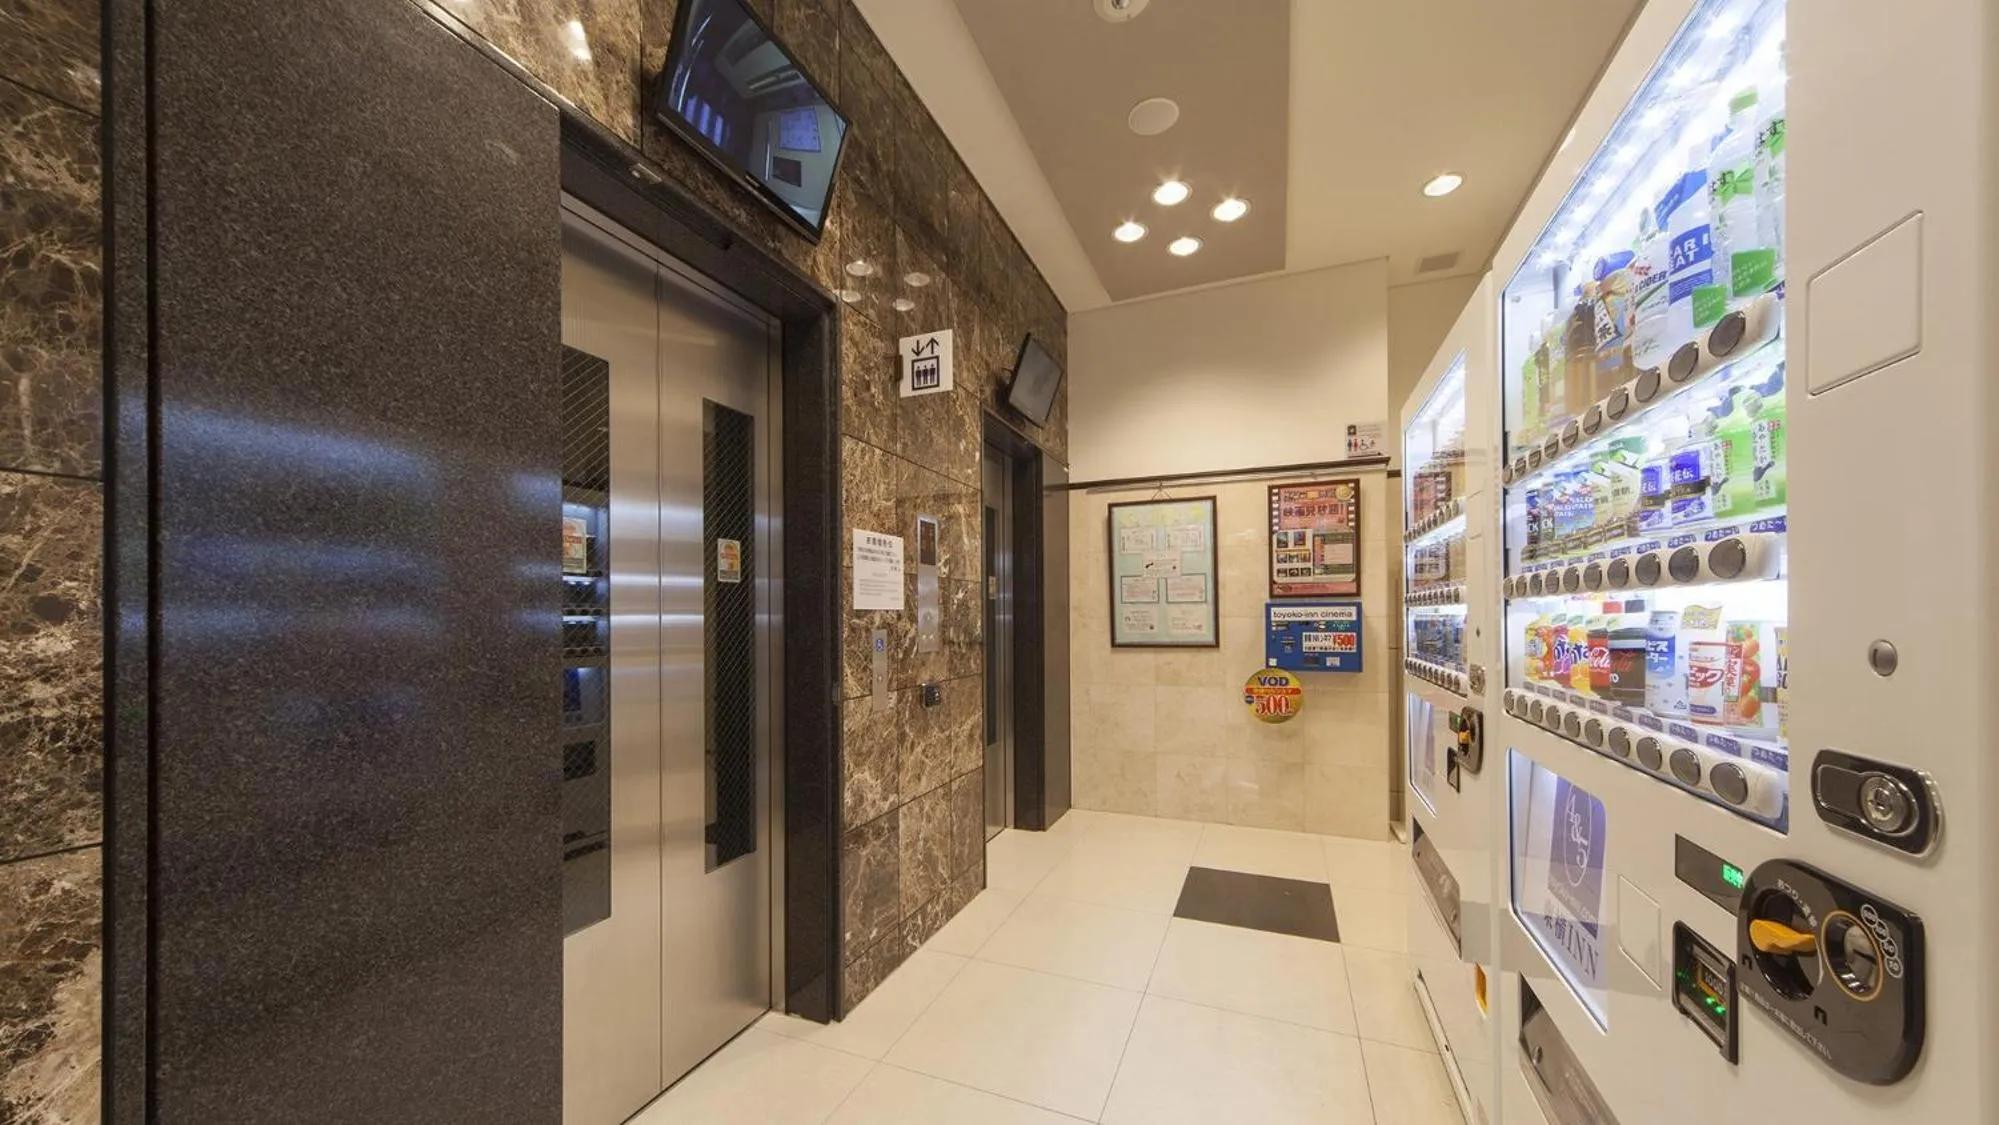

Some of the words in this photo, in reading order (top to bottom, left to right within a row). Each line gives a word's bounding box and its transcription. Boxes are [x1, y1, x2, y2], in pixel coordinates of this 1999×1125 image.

[1320, 610, 1353, 618] cinema
[1257, 677, 1290, 687] VOD
[1256, 695, 1290, 715] 500
